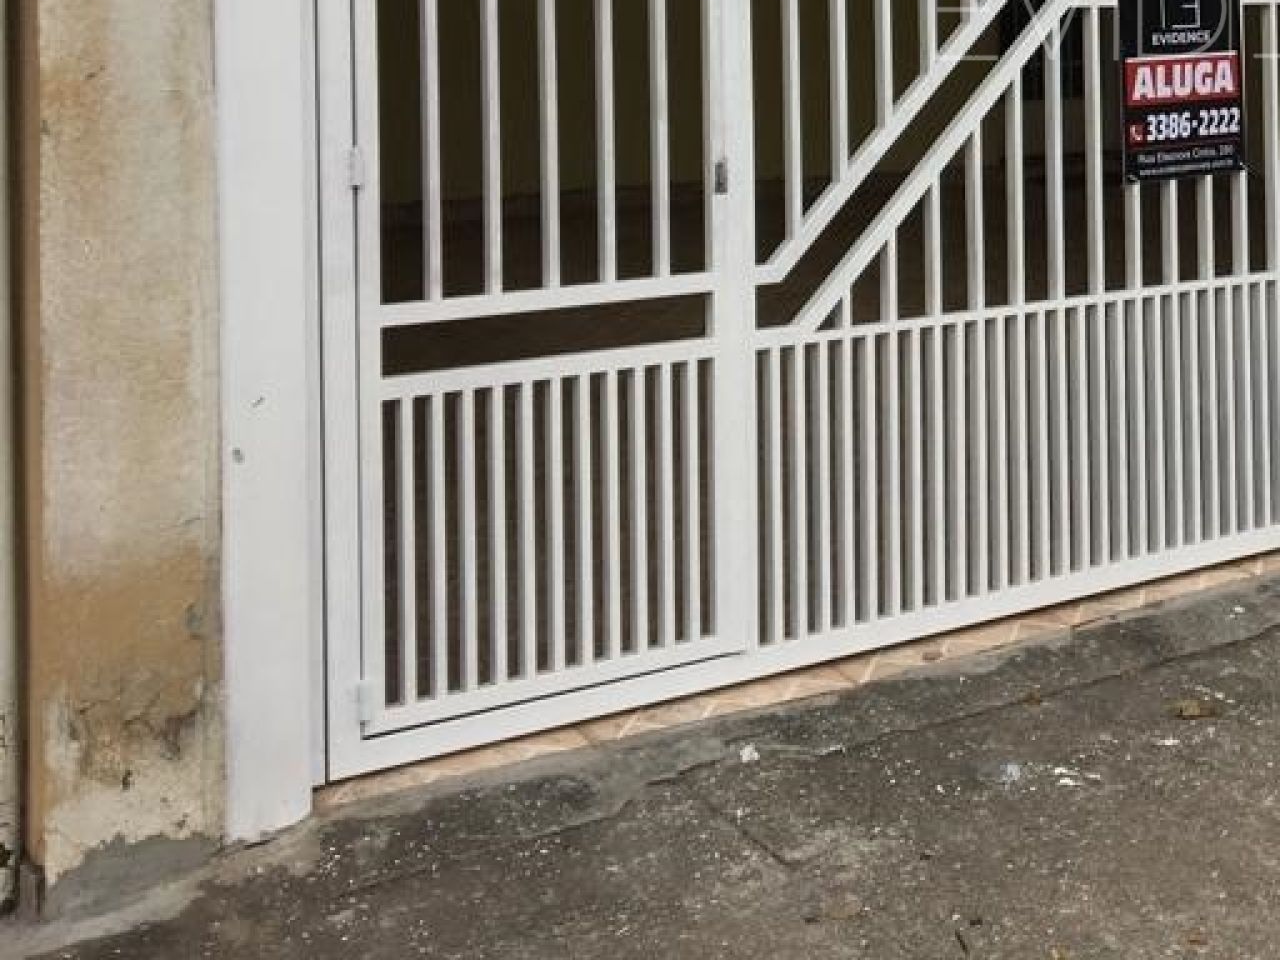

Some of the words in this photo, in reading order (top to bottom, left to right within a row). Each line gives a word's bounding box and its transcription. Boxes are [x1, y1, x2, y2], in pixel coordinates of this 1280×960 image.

[1151, 29, 1211, 46] EVIDENCE
[1132, 59, 1234, 100] ALUGA
[1147, 106, 1241, 141] 3386-2222
